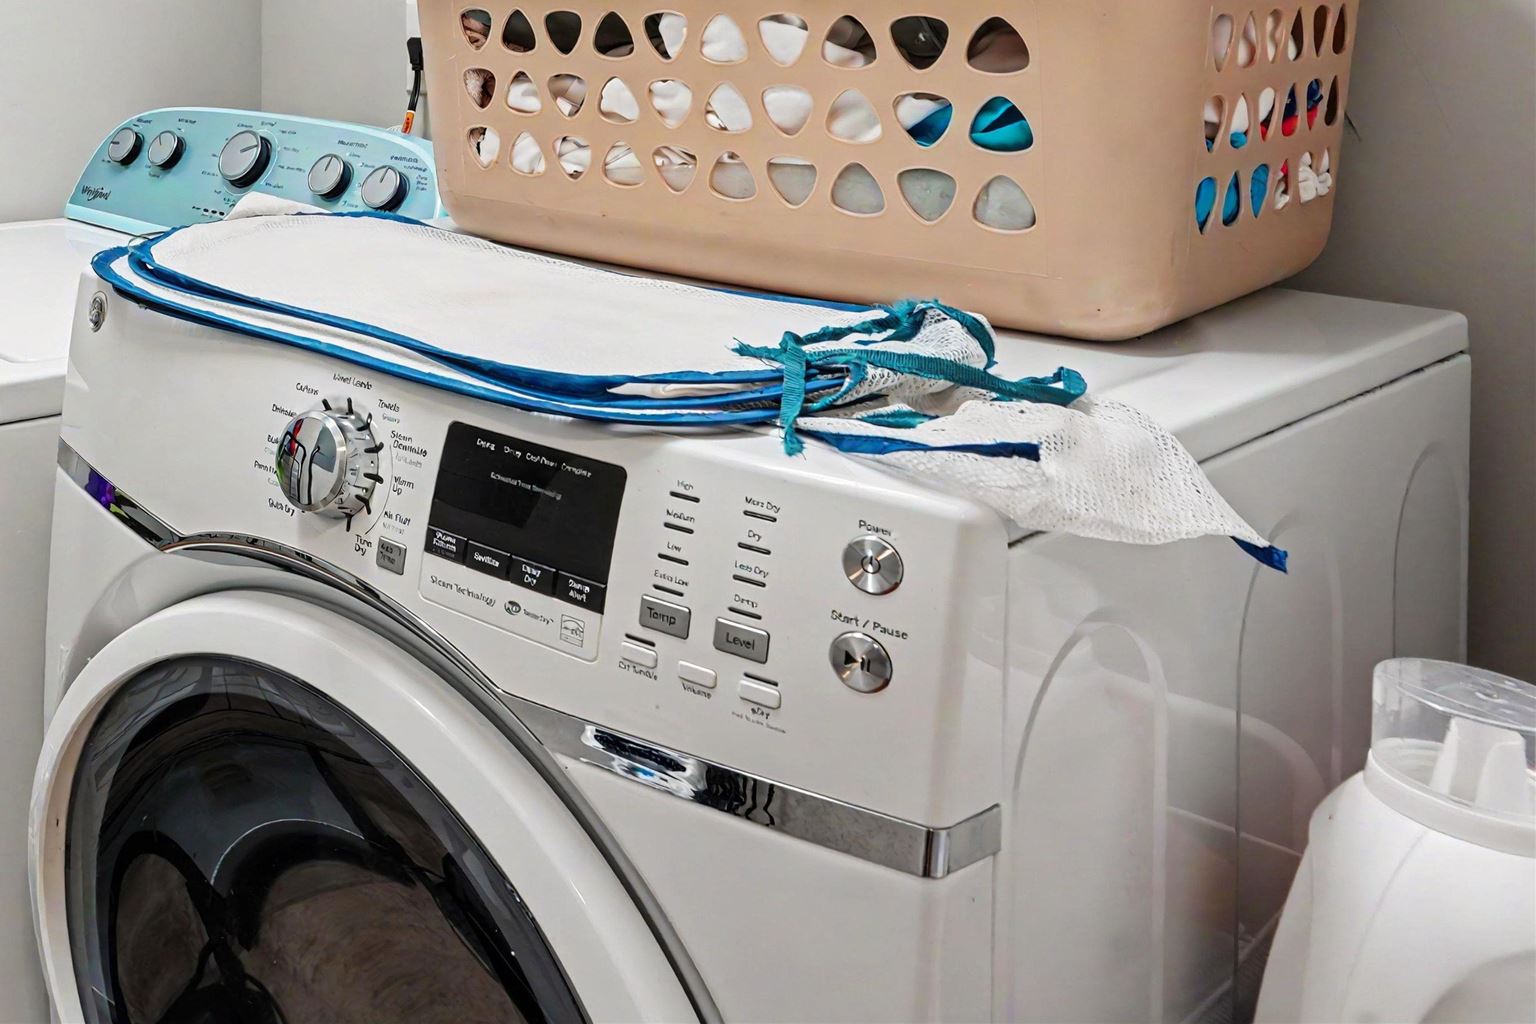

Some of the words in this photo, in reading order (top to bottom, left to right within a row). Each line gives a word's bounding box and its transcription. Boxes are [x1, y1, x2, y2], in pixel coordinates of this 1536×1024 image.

[830, 609, 860, 627] Start
[872, 620, 909, 640] Pause
[725, 631, 756, 652] Level
